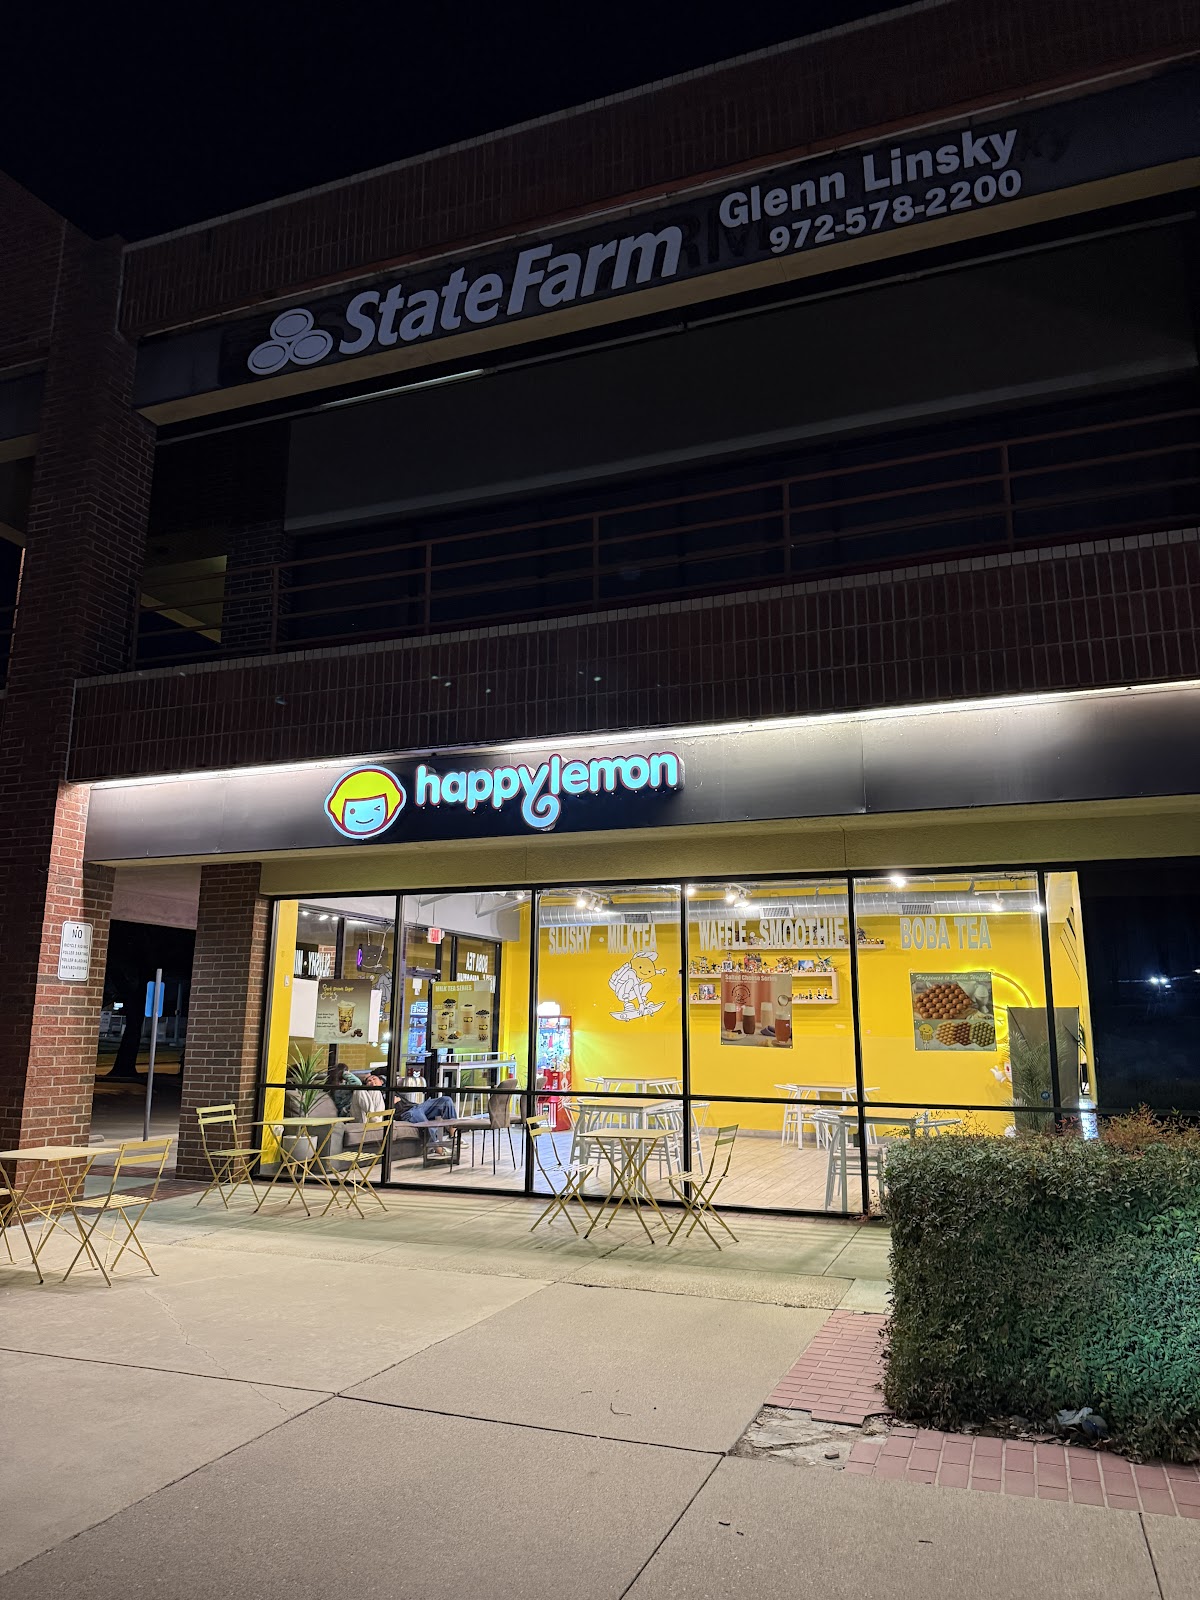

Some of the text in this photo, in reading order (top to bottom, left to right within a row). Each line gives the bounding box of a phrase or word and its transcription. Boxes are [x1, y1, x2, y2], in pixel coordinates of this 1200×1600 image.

[719, 171, 847, 229] Glenn
[863, 128, 1018, 193] Linsky
[769, 169, 1022, 253] 972-578-2200
[72, 929, 83, 939] NO
[548, 922, 658, 955] SLUSHY MILKTEA
[699, 917, 846, 951] WAFFLE SMOOTHIE
[900, 916, 992, 950] BOBA TEA
[915, 974, 944, 982] Happiness
